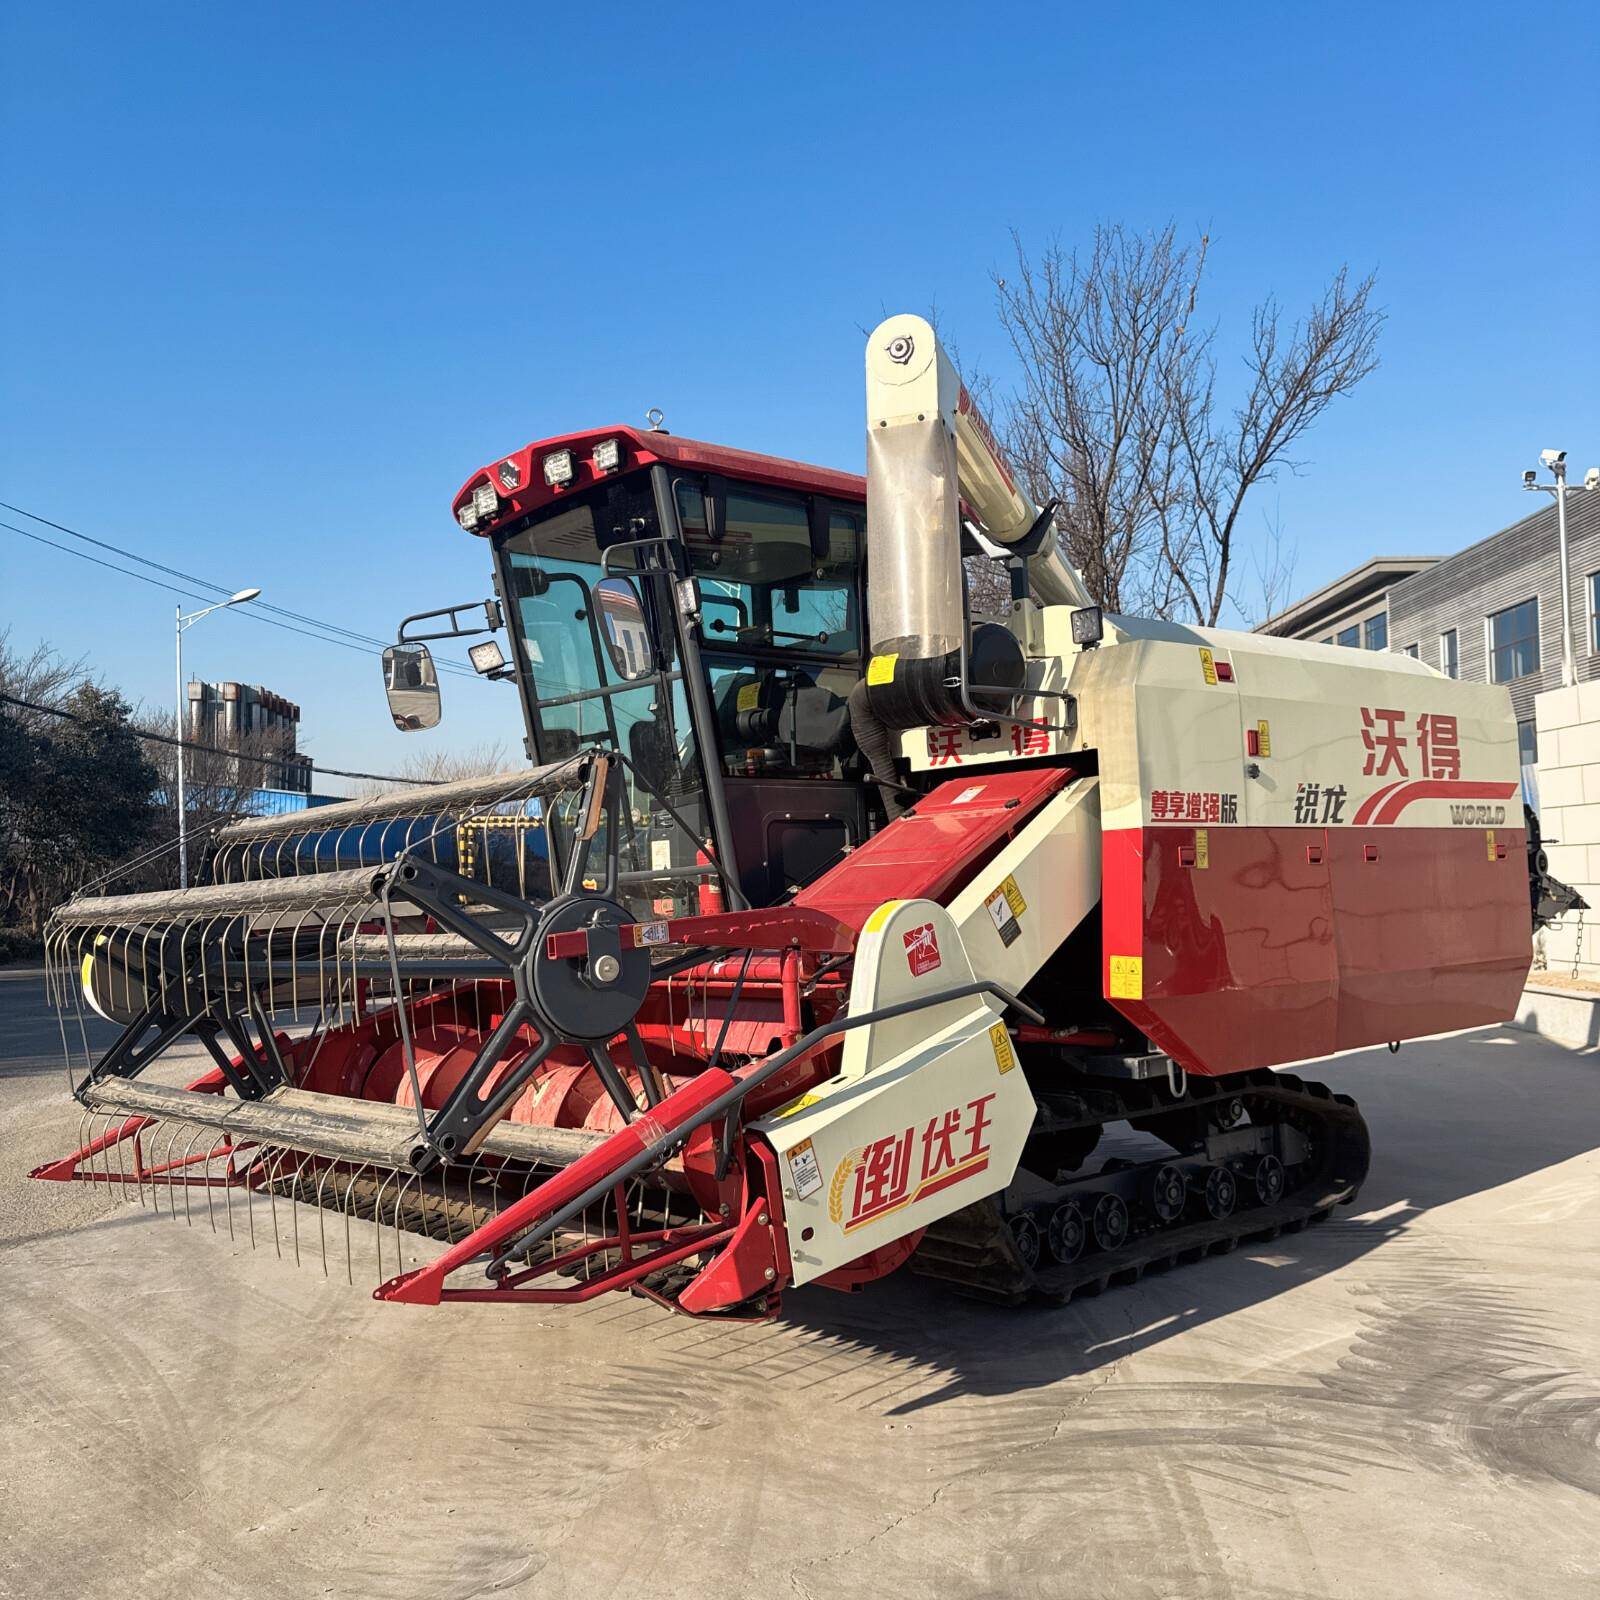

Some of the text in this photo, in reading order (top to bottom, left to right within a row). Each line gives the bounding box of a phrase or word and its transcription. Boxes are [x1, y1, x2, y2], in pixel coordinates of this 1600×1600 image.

[1360, 706, 1461, 780] 沃得
[1151, 790, 1238, 824] 尊享增强版
[1294, 783, 1348, 825] 锐龙
[1449, 804, 1505, 825] WORLD
[852, 1092, 997, 1218] 倒伏王
